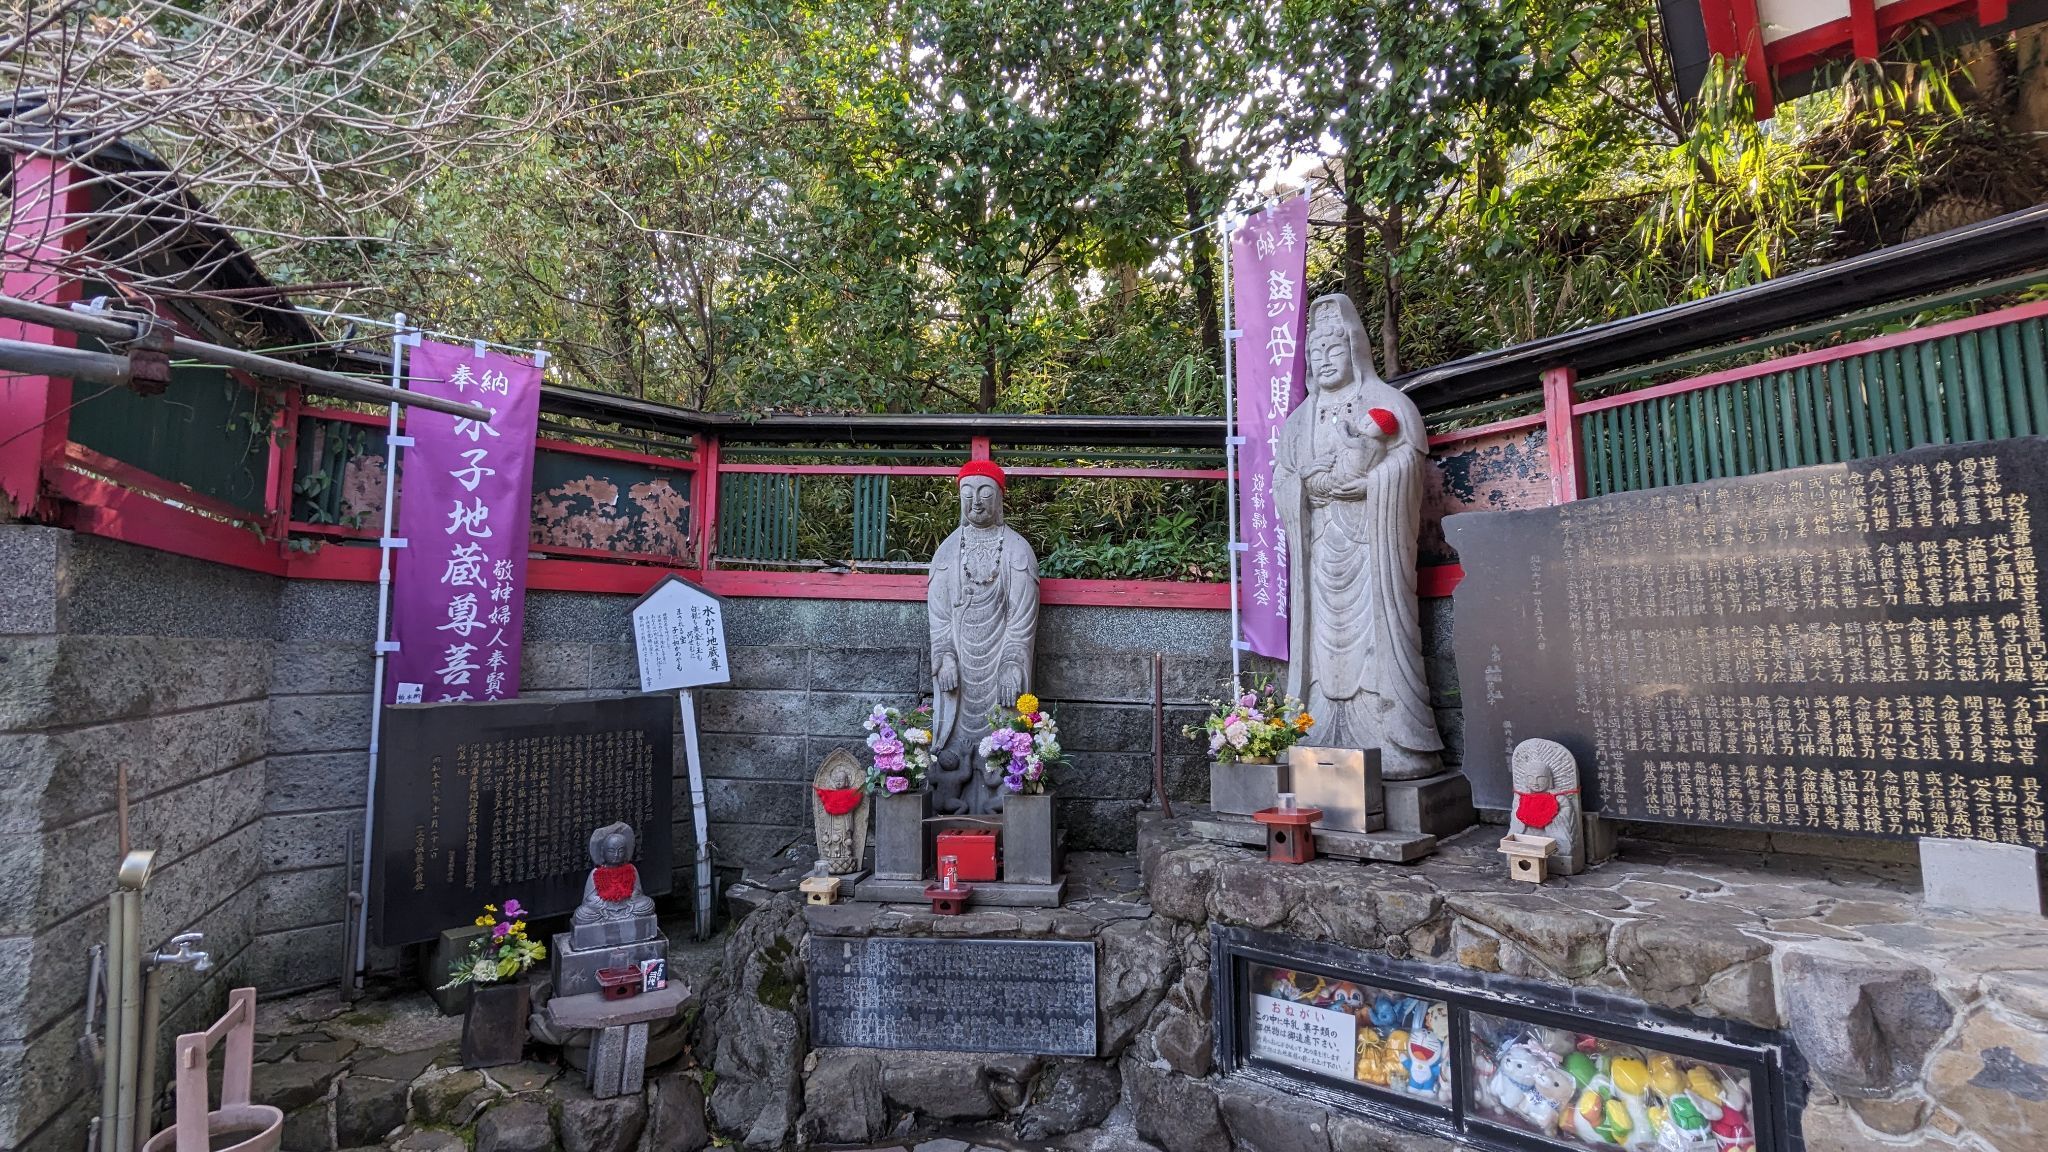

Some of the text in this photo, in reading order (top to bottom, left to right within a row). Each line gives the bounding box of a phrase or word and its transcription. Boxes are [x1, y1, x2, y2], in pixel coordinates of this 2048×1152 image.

[448, 363, 509, 397] 奉納
[433, 398, 501, 703] 水子地蔵尊菩
[702, 605, 722, 672] 水かけ地蔵尊
[1272, 1002, 1324, 1023] おねがい
